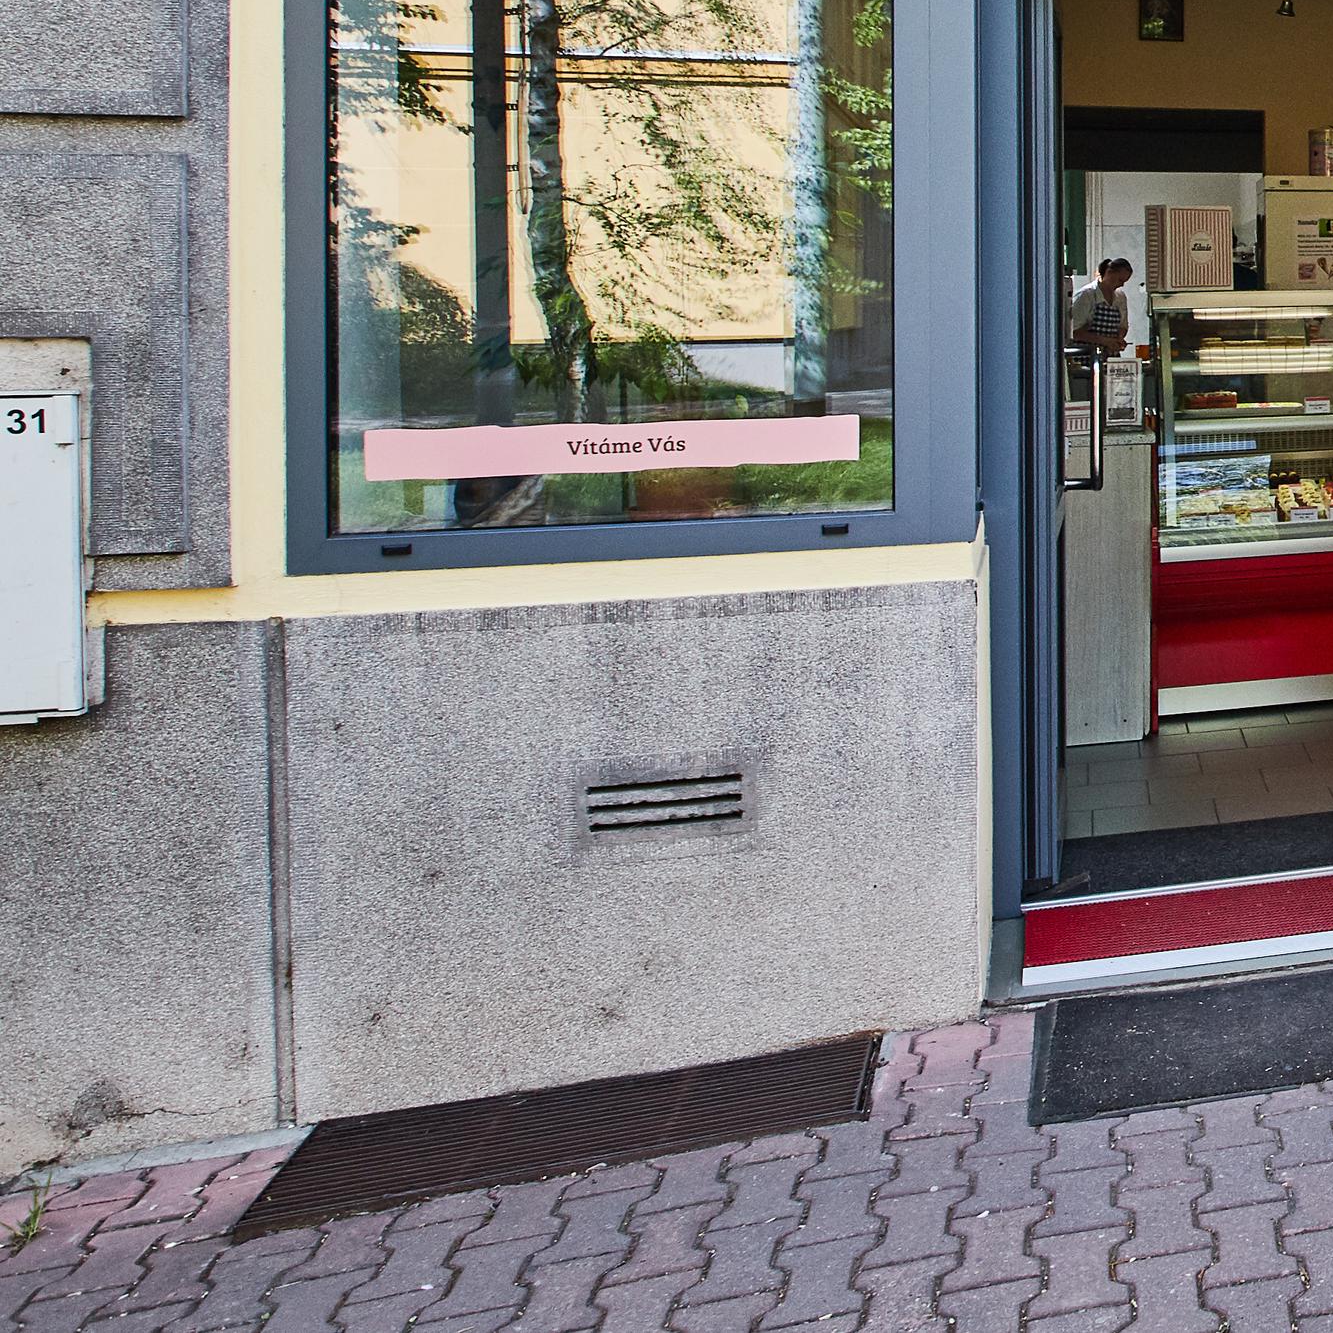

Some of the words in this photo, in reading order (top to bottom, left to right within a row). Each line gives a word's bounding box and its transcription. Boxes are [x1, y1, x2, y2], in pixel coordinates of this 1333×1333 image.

[6, 408, 46, 435] 31
[566, 437, 644, 457] Vítáme
[647, 436, 687, 453] Vás
